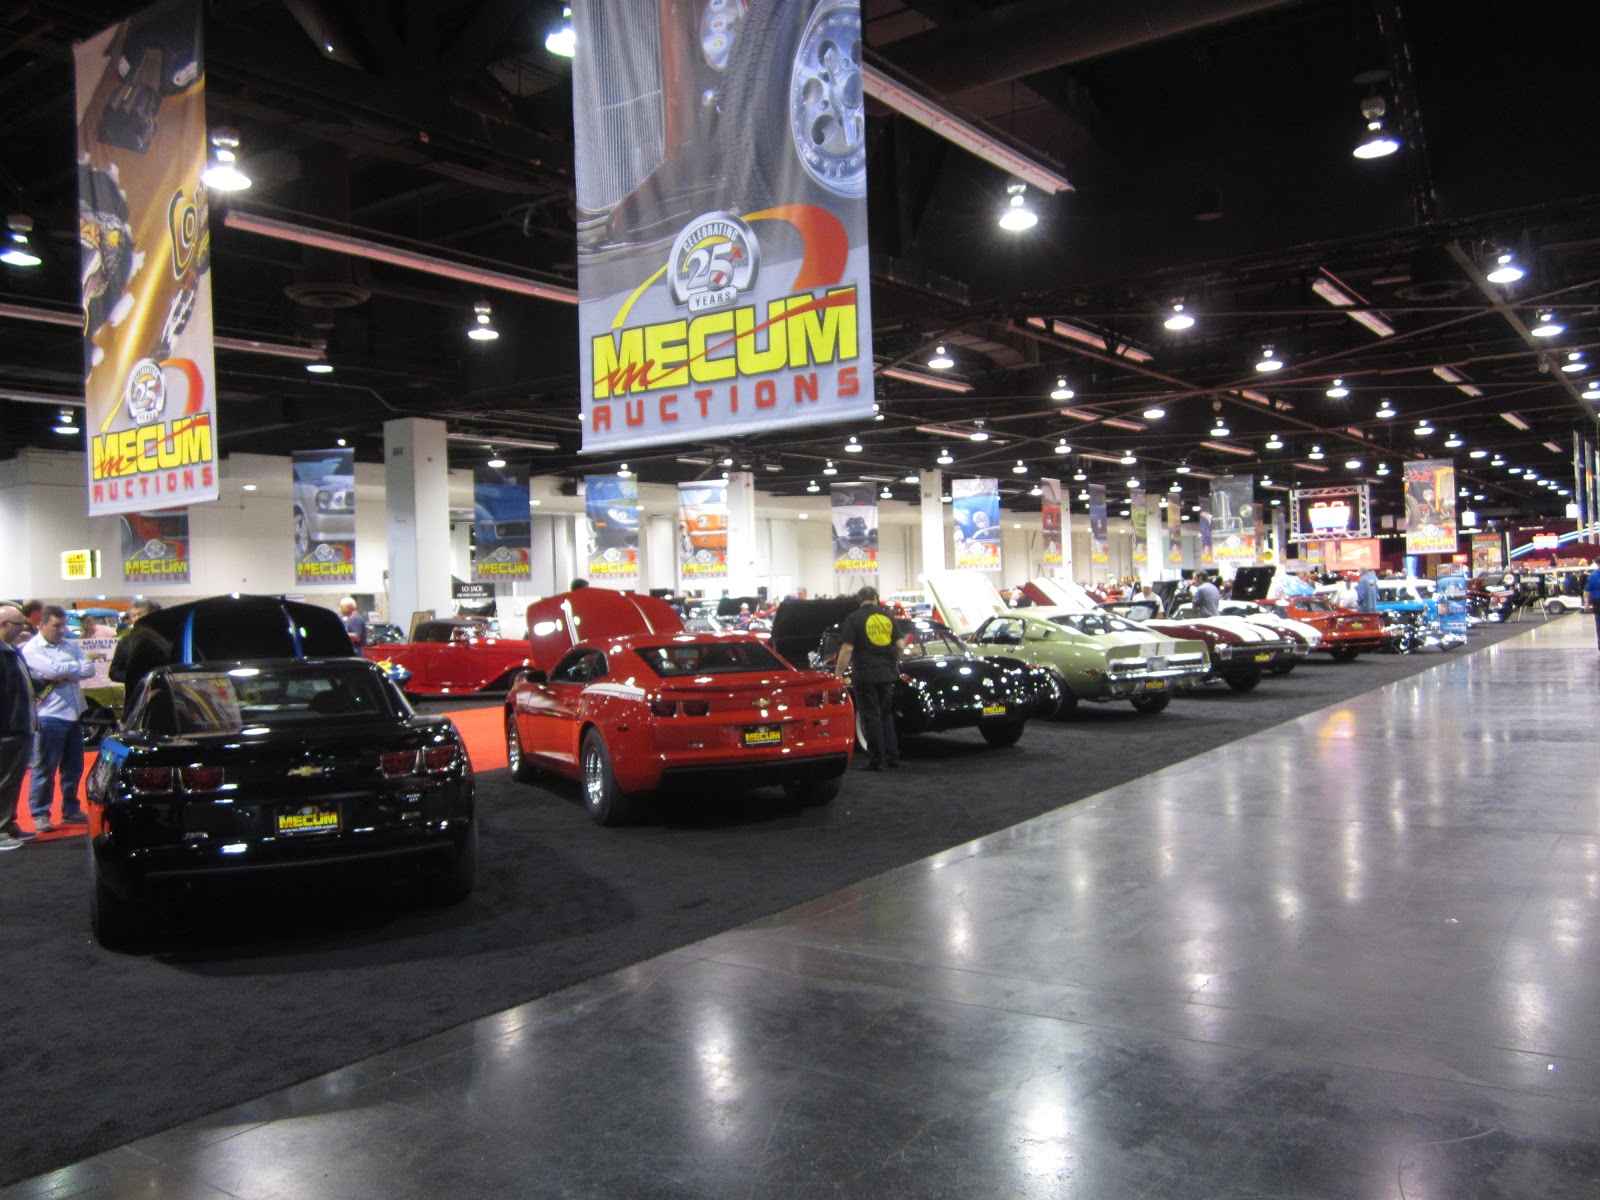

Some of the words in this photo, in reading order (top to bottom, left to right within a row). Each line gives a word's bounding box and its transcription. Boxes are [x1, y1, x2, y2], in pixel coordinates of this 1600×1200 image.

[683, 223, 739, 252] CELEBRATING
[686, 241, 734, 291] 25
[694, 291, 731, 307] YEARS
[591, 283, 859, 401] MECUM
[136, 379, 157, 411] 25
[592, 365, 860, 432] AUCTIONS
[92, 412, 213, 481] MECUM
[93, 465, 214, 503] AUCTIONS
[1409, 536, 1455, 547] MECUM
[125, 559, 188, 575] MECUM
[297, 561, 354, 576] MECUM
[477, 562, 530, 575] MECUM
[589, 562, 638, 574] MECUM
[682, 562, 727, 574] MECUM
[835, 559, 878, 569] MECUM
[745, 731, 781, 742] MECUM
[278, 811, 338, 829] MECUM
